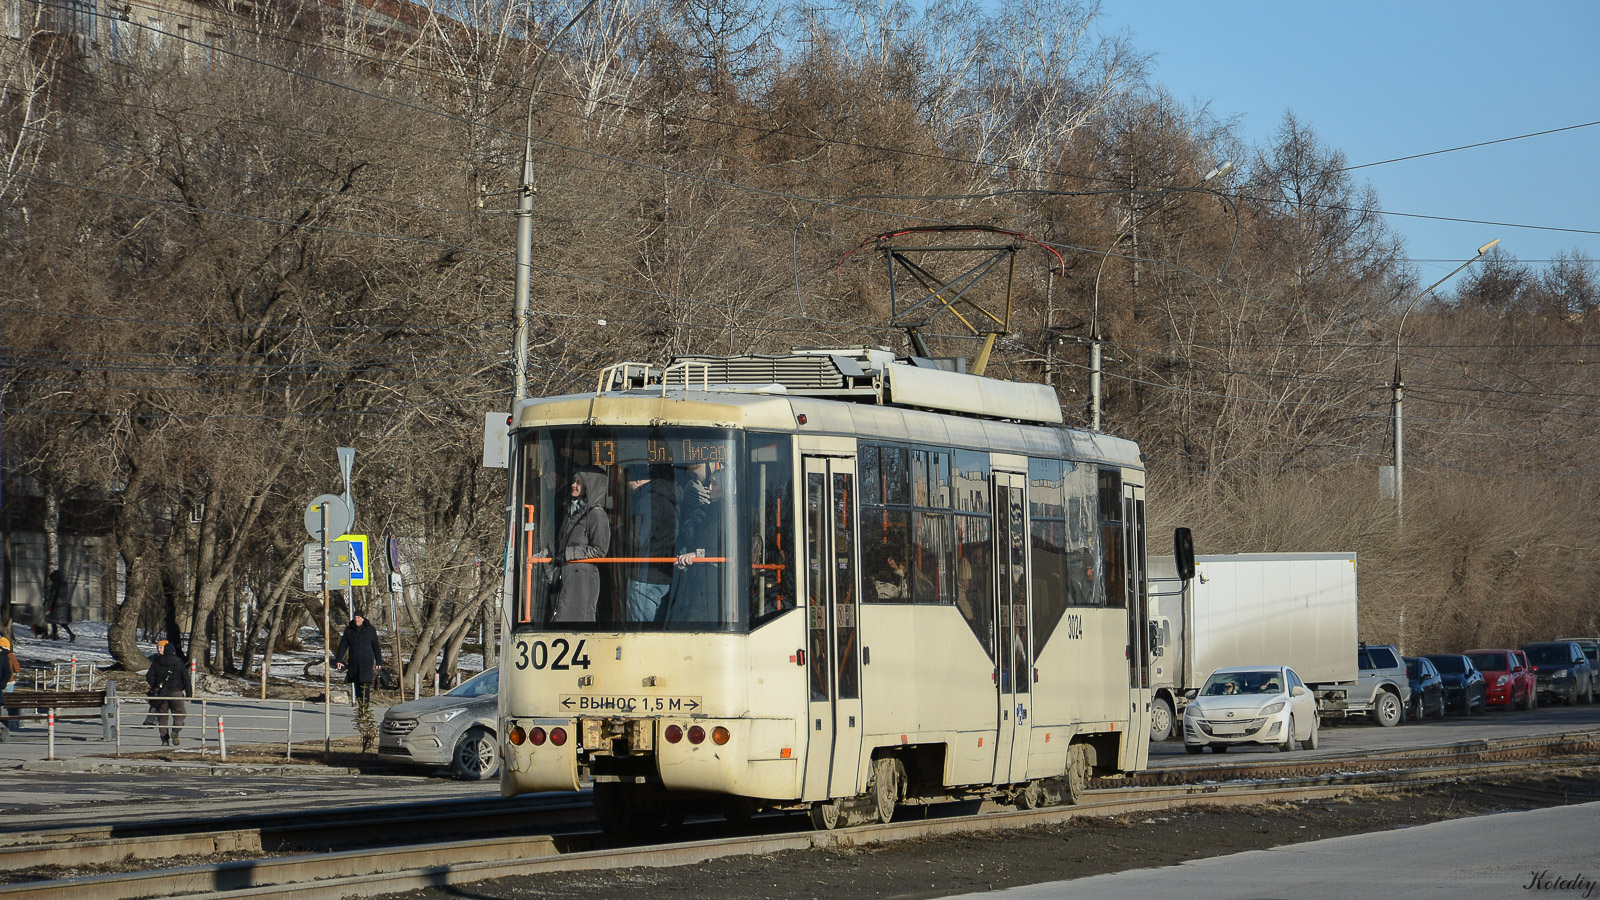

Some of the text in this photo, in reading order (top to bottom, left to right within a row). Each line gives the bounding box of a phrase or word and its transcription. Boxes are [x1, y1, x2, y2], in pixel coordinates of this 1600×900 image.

[594, 440, 615, 466] 13
[647, 438, 674, 462] Ул.
[1068, 614, 1083, 640] 3024
[515, 638, 591, 670] 3024
[580, 696, 681, 713] ВЫНОС 1,5 М
